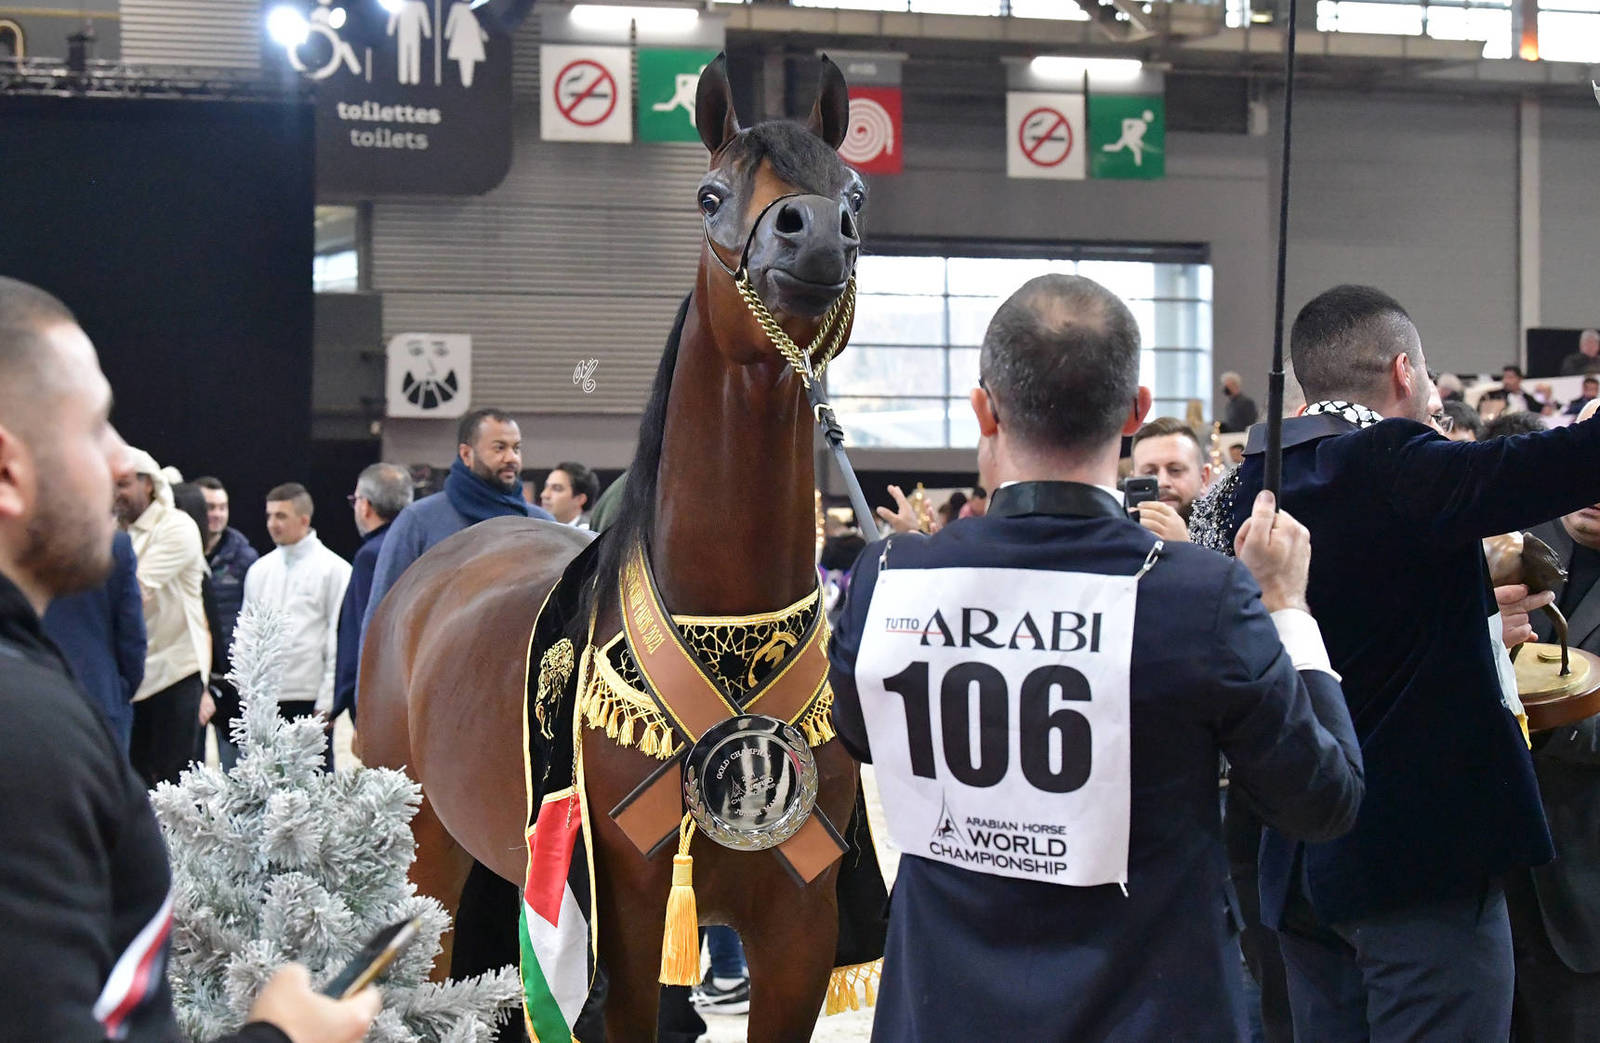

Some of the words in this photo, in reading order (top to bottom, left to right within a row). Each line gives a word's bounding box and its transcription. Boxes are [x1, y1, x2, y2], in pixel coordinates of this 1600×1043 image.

[337, 101, 441, 124] toilettes
[351, 128, 428, 149] toilets
[885, 617, 920, 631] TUTTO
[920, 607, 1103, 653] ARABI
[883, 661, 1092, 793] 106
[716, 759, 730, 780] GOLD
[966, 816, 1018, 831] ARABIAN
[1022, 823, 1067, 836] HORSE
[968, 828, 1067, 858] WORLD
[929, 841, 1067, 876] CHAMPIONSHIP
